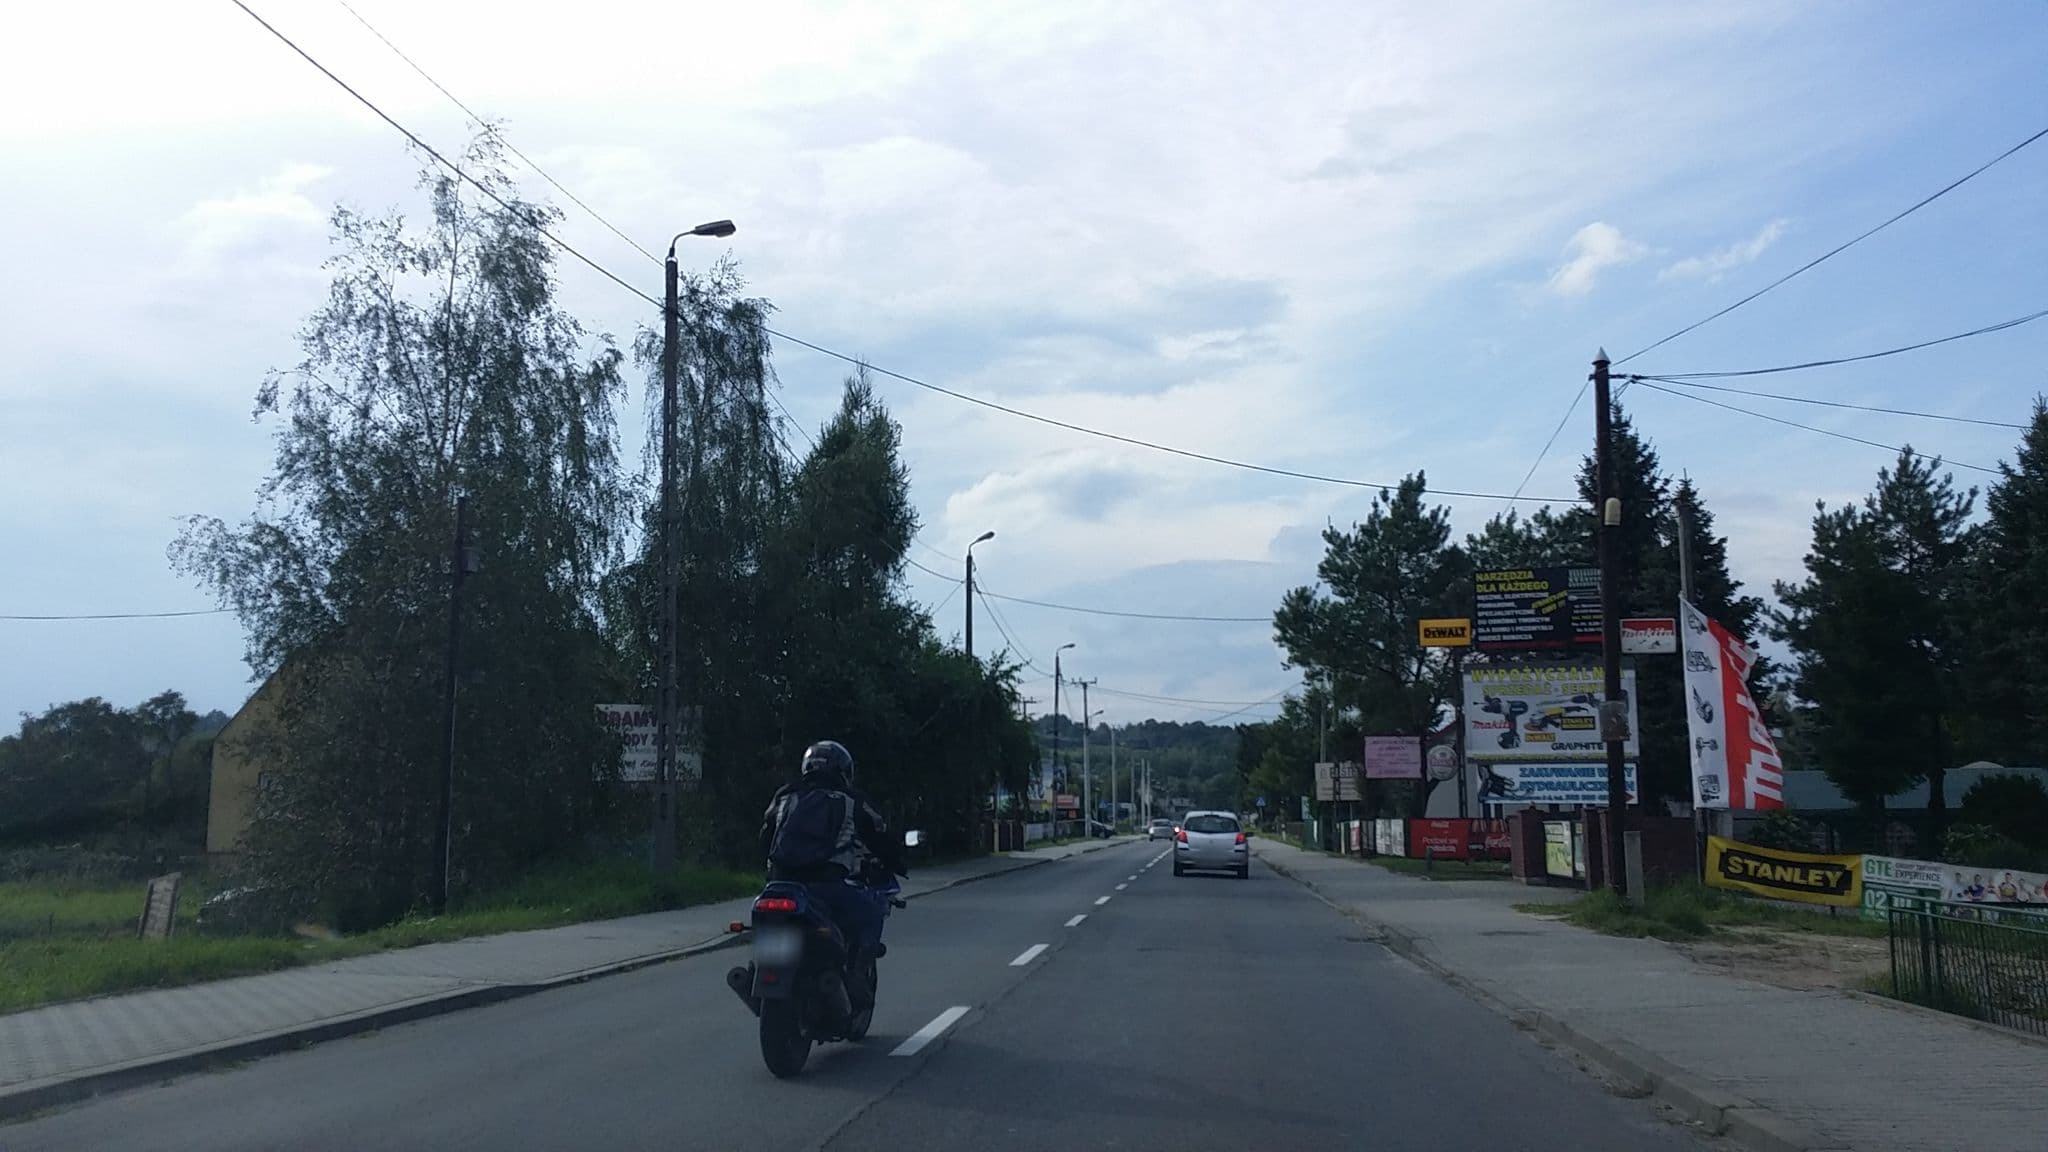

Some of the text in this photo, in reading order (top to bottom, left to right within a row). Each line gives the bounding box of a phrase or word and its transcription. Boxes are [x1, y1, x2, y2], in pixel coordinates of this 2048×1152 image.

[1476, 580, 1549, 593] DLA KAŻDEGO
[1471, 665, 1625, 684] WYPOŻYCZALN
[1561, 683, 1606, 695] SERW
[1551, 742, 1604, 752] GRAPHITE
[1519, 767, 1596, 778] ZAKUWANIE
[1519, 781, 1635, 792] HYDRAULICZNH
[1727, 855, 1844, 889] STANLEY
[1864, 859, 1894, 879] GTE
[1895, 869, 1942, 883] EXPERIENCE
[1864, 889, 1888, 910] 02
